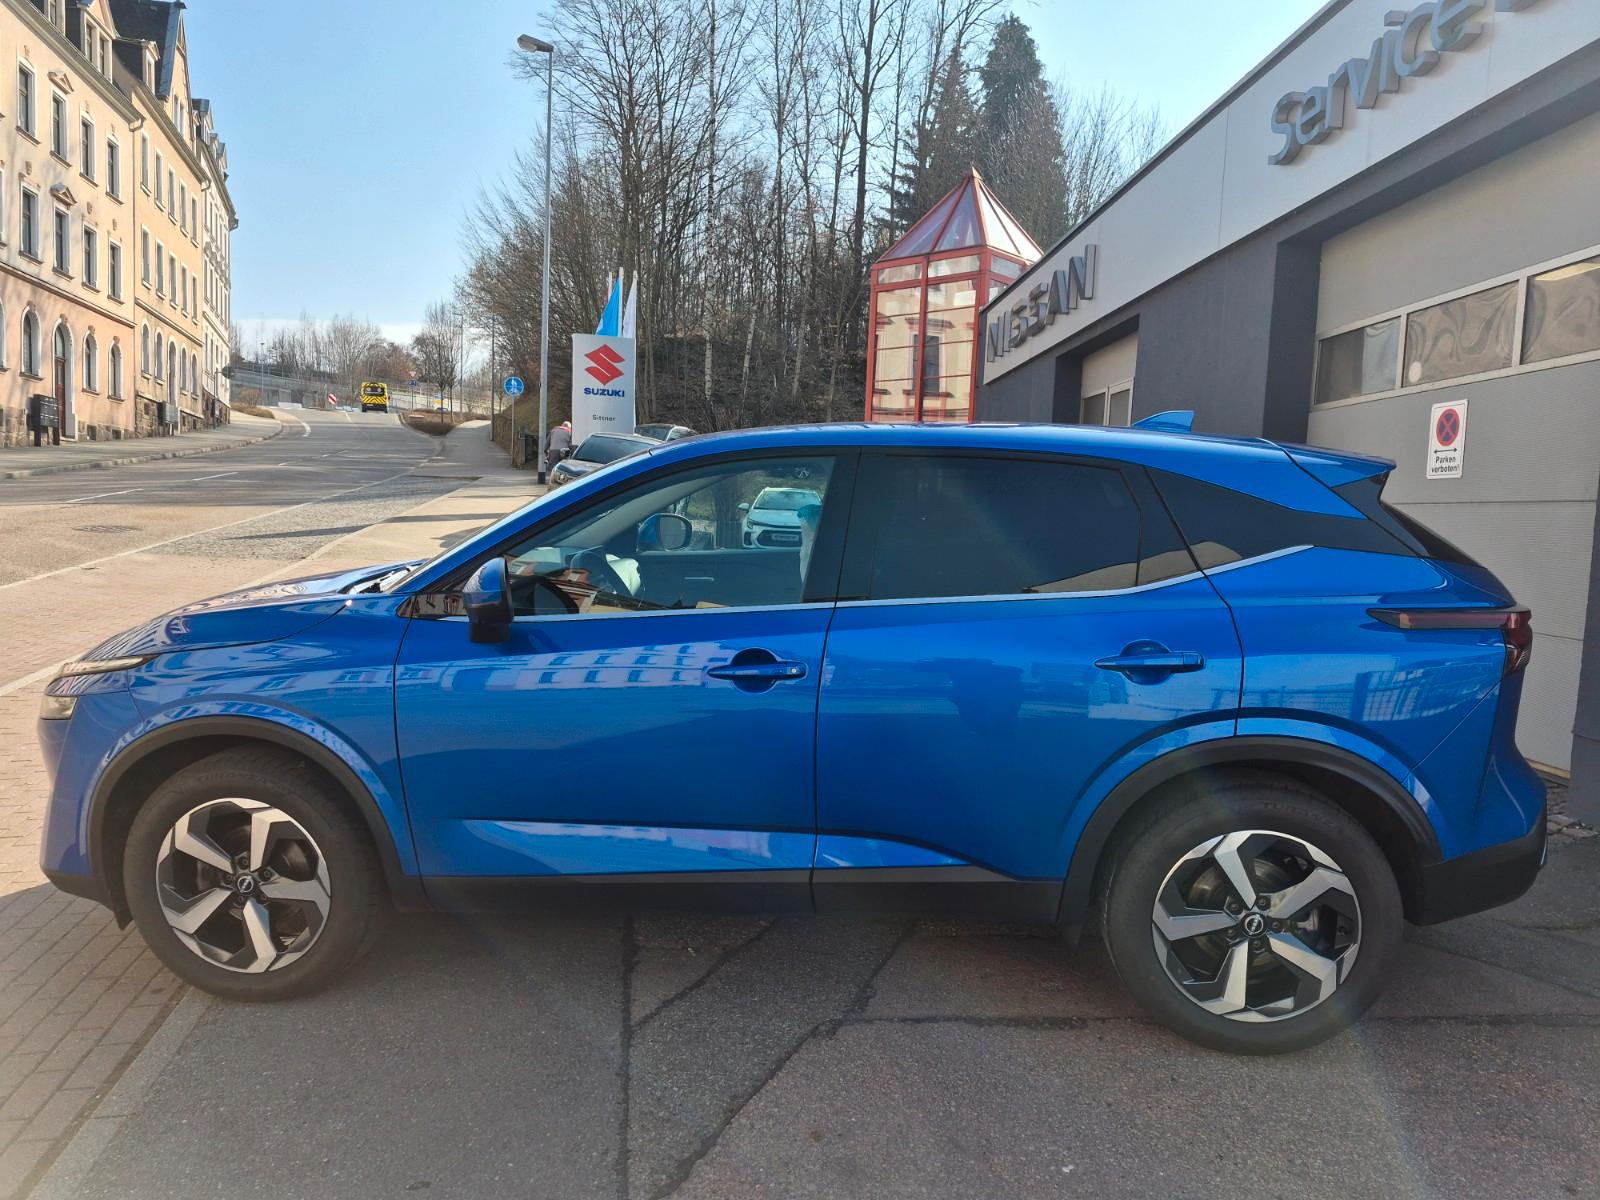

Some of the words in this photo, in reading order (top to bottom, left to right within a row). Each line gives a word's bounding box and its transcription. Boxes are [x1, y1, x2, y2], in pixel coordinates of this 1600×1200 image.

[986, 244, 1097, 363] NISSAN
[583, 387, 625, 398] SUZUKI
[1435, 456, 1457, 464] Parken
